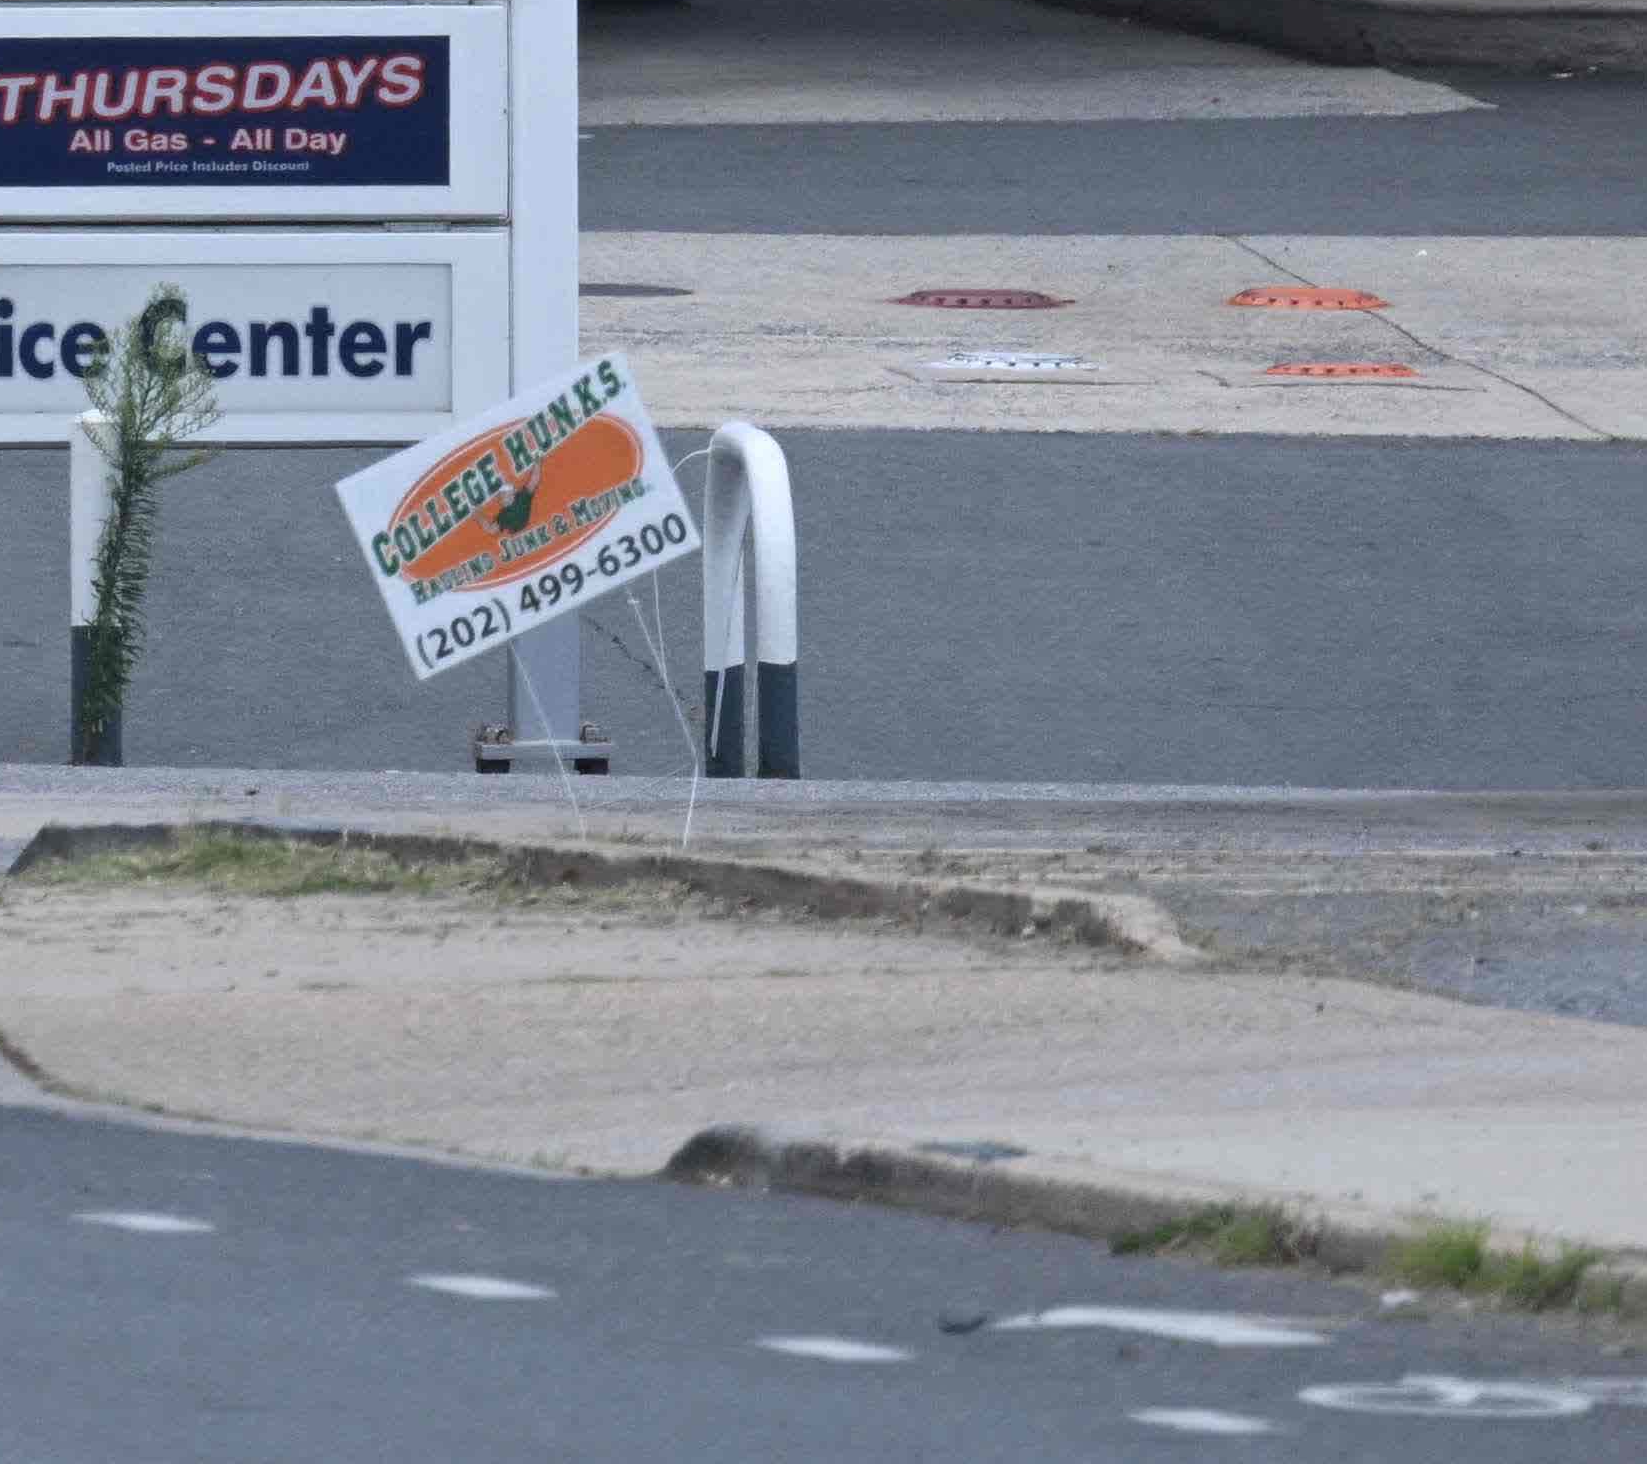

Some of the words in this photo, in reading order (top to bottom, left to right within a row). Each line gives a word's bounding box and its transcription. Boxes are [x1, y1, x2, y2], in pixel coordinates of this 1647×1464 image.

[69, 128, 111, 152] All
[124, 128, 188, 152] Gas
[231, 128, 274, 151] All
[284, 127, 347, 155] Day
[107, 161, 152, 173] Posted
[155, 161, 189, 172] Price
[192, 161, 249, 172] Includes
[252, 160, 310, 172] Discount
[371, 449, 505, 578] COLLEGE
[415, 598, 512, 670] (202)
[518, 511, 688, 614] 499-6300
